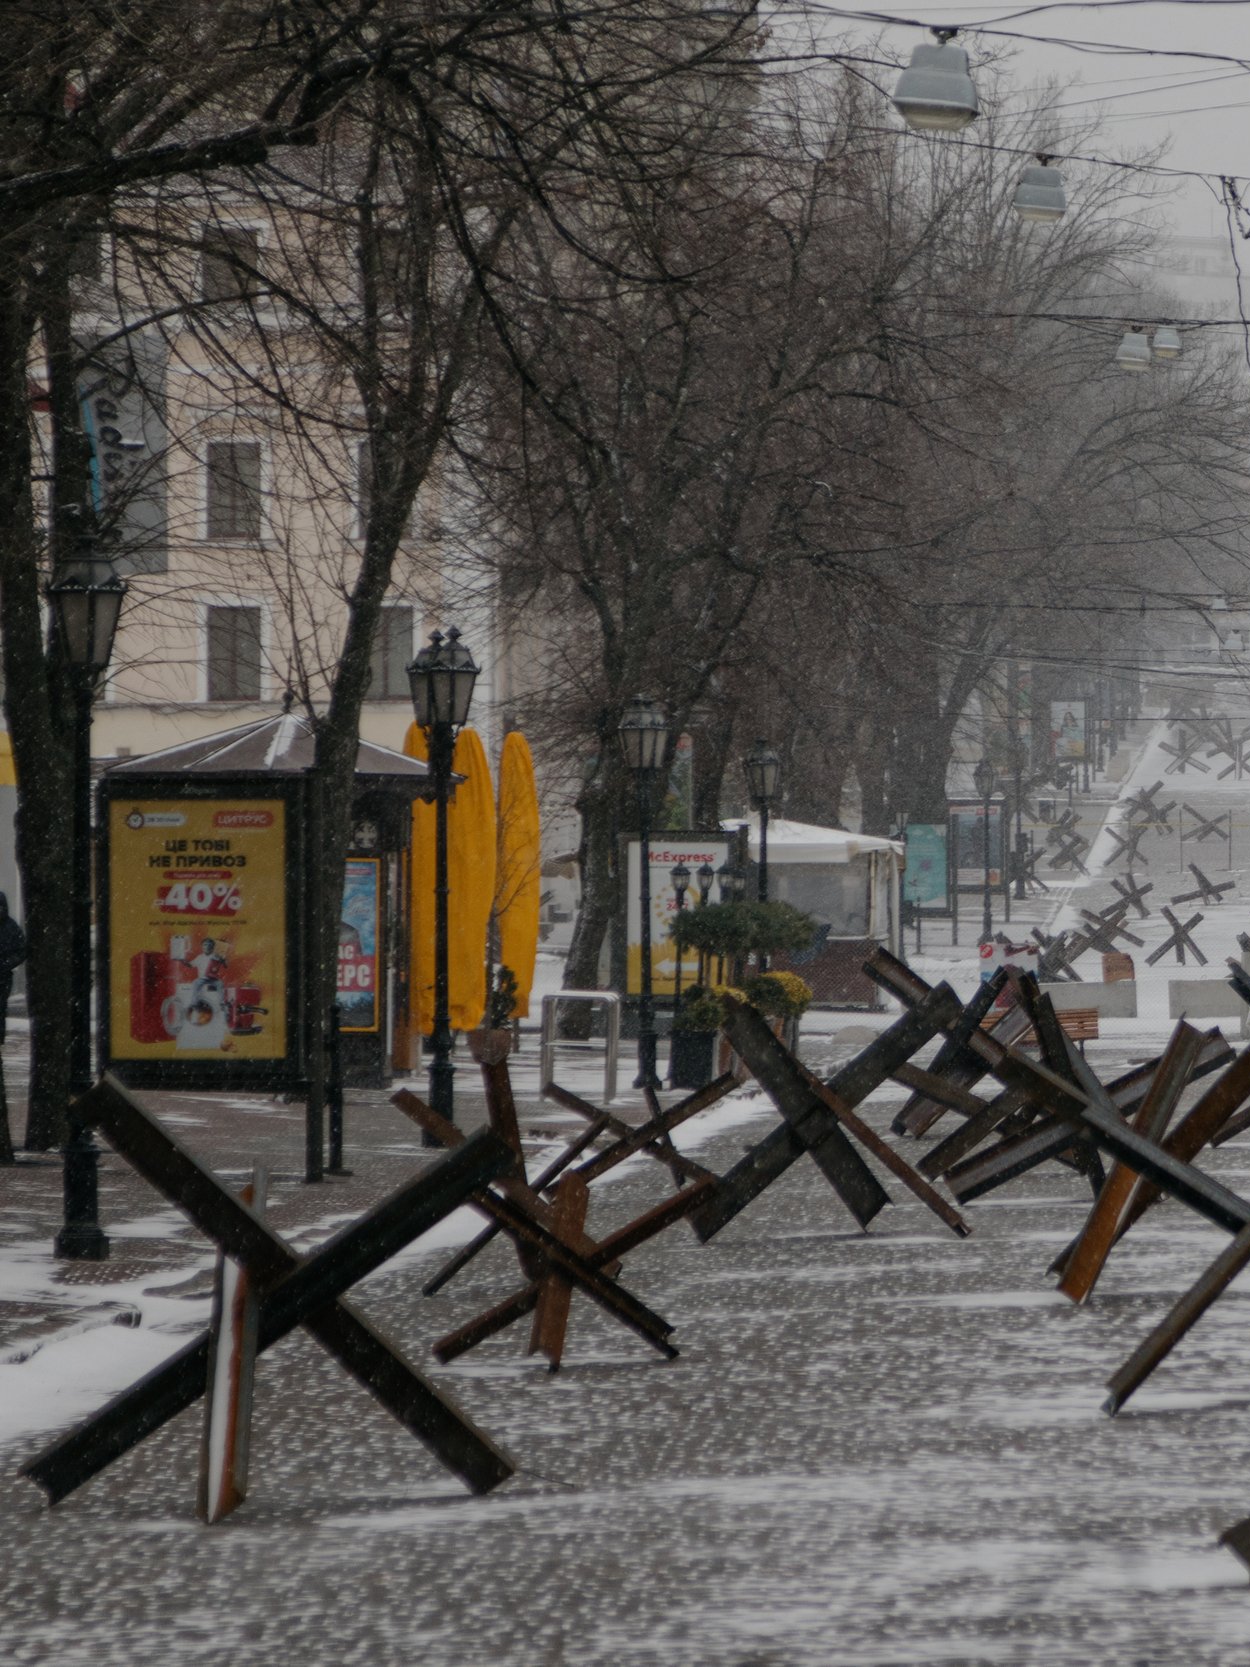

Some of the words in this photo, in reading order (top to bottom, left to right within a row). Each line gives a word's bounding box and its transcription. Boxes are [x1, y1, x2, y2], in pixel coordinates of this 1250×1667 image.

[217, 815, 268, 826] ЦИТРУС
[165, 840, 188, 851] ЦЕ
[192, 840, 230, 851] ТОБІ
[149, 856, 171, 867] НЕ
[176, 856, 246, 867] ПРИВОЗ
[648, 851, 714, 863] McExpress
